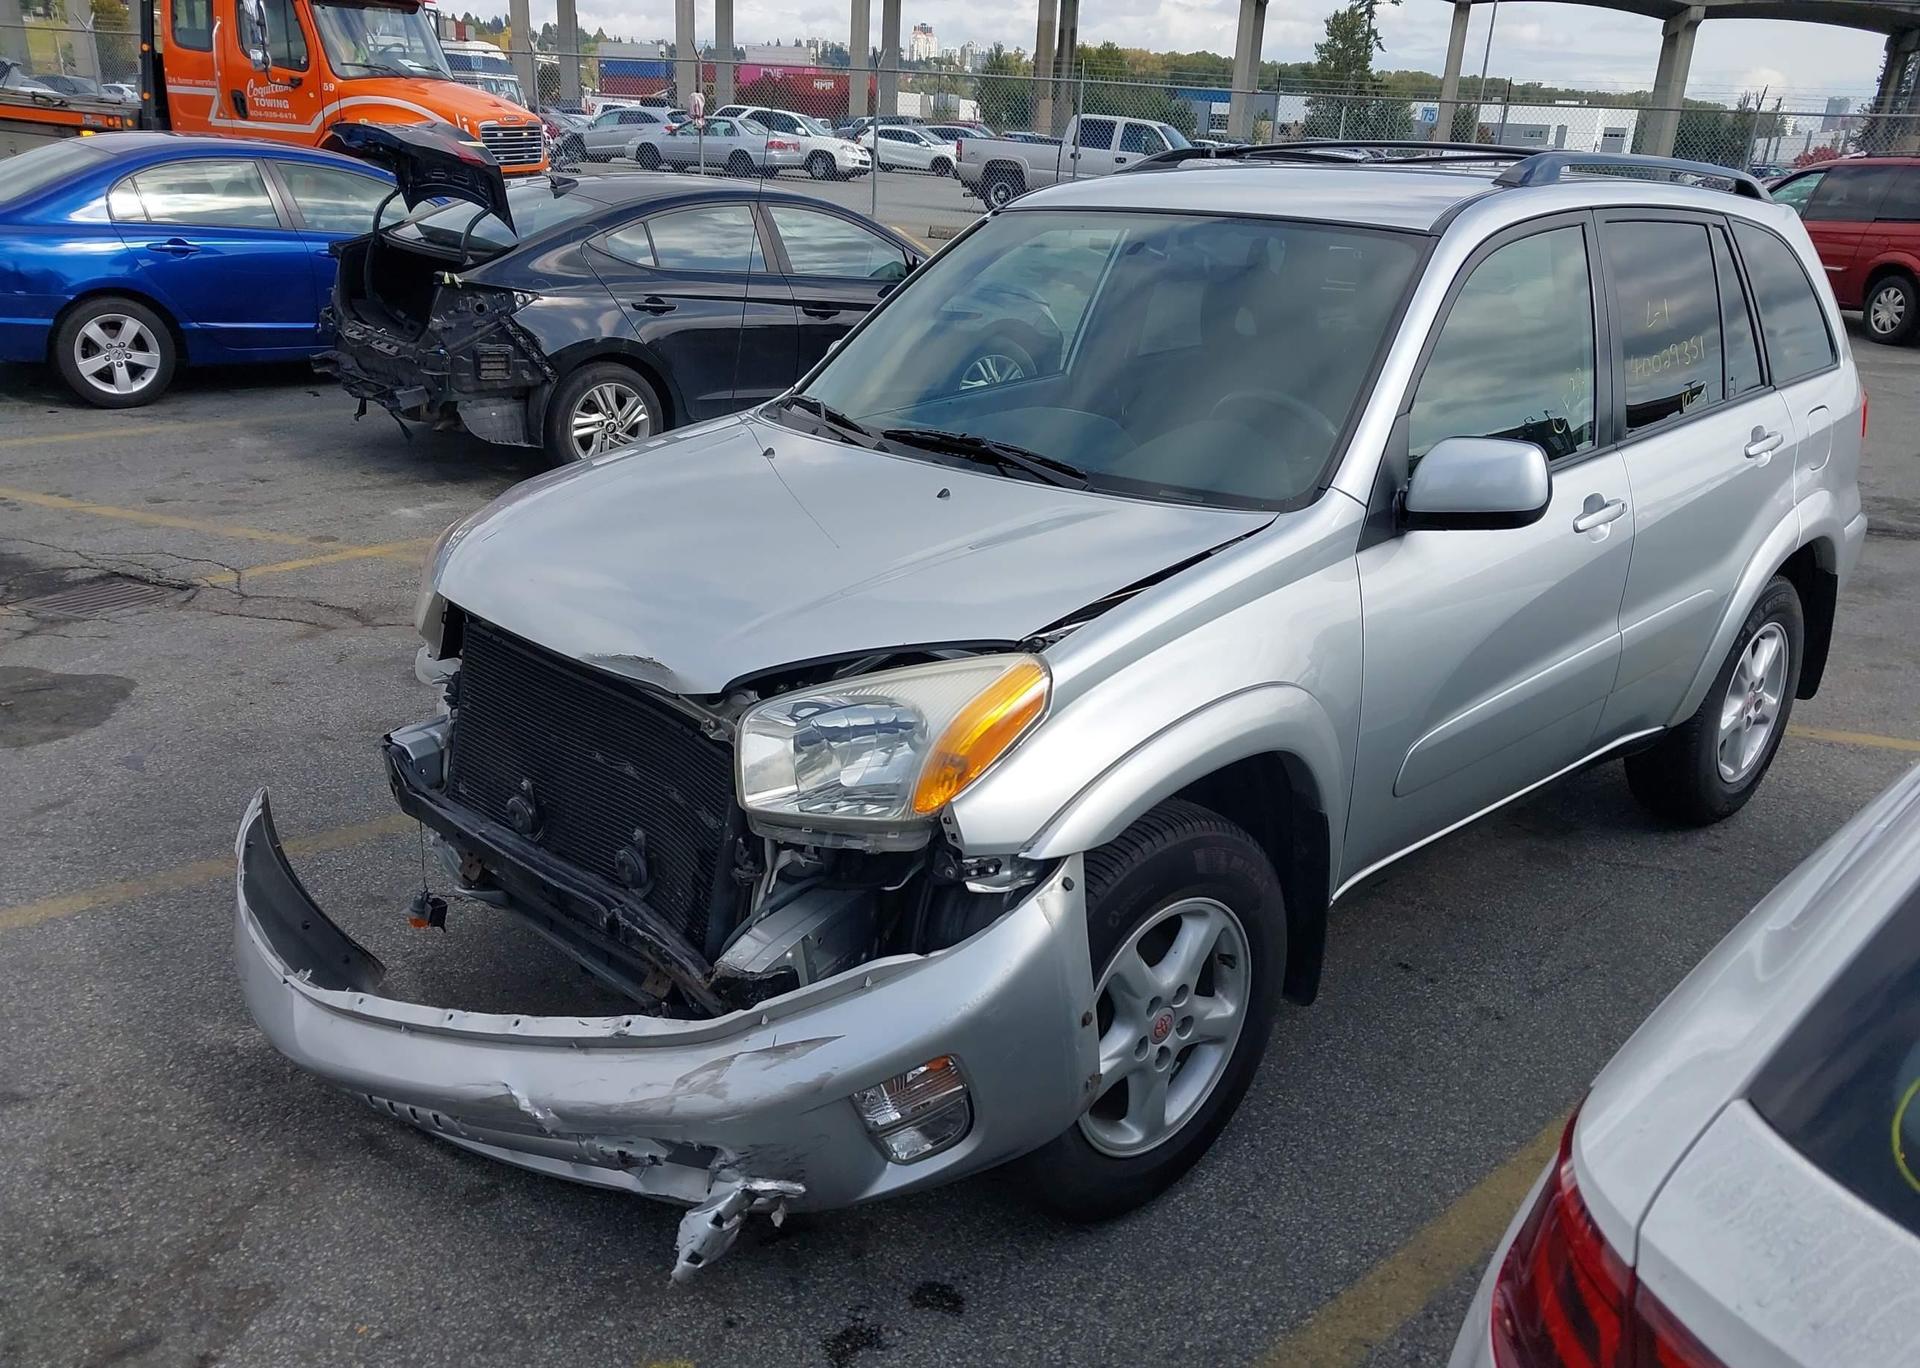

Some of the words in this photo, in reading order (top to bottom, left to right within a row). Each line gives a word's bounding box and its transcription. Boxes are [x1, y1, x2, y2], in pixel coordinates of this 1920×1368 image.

[323, 82, 335, 92] 59
[814, 78, 834, 90] HMM
[253, 97, 290, 109] TOWING
[1424, 110, 1436, 122] 75
